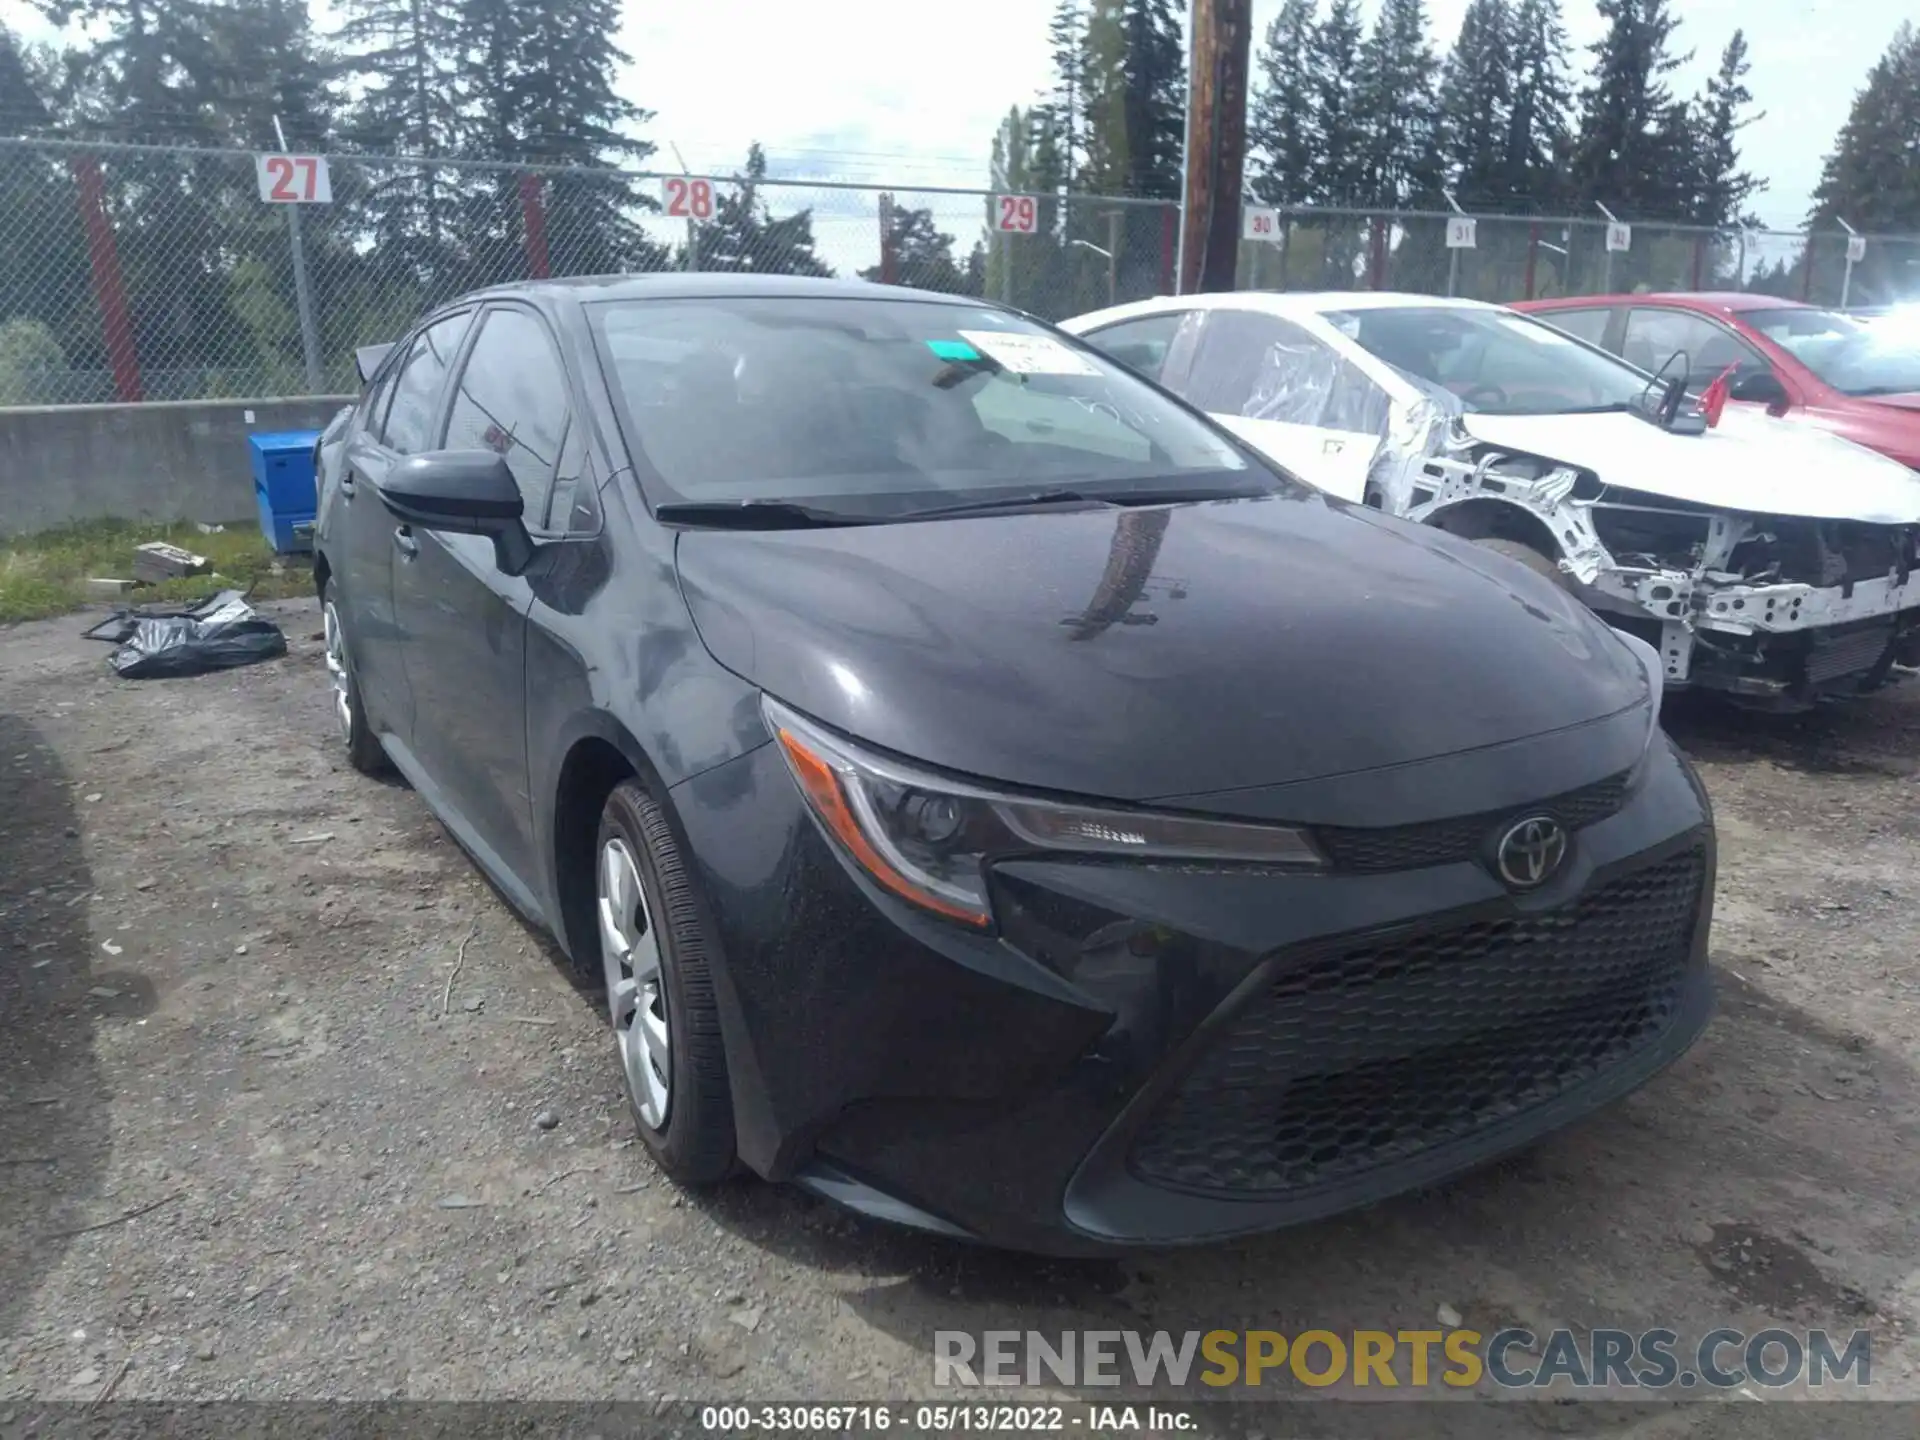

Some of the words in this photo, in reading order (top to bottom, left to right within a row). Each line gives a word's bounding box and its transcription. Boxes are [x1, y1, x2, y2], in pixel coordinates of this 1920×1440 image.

[267, 157, 317, 200] 27
[667, 178, 712, 218] 28
[1000, 196, 1033, 231] 29
[1253, 214, 1271, 233] 30
[1456, 224, 1470, 241] 31
